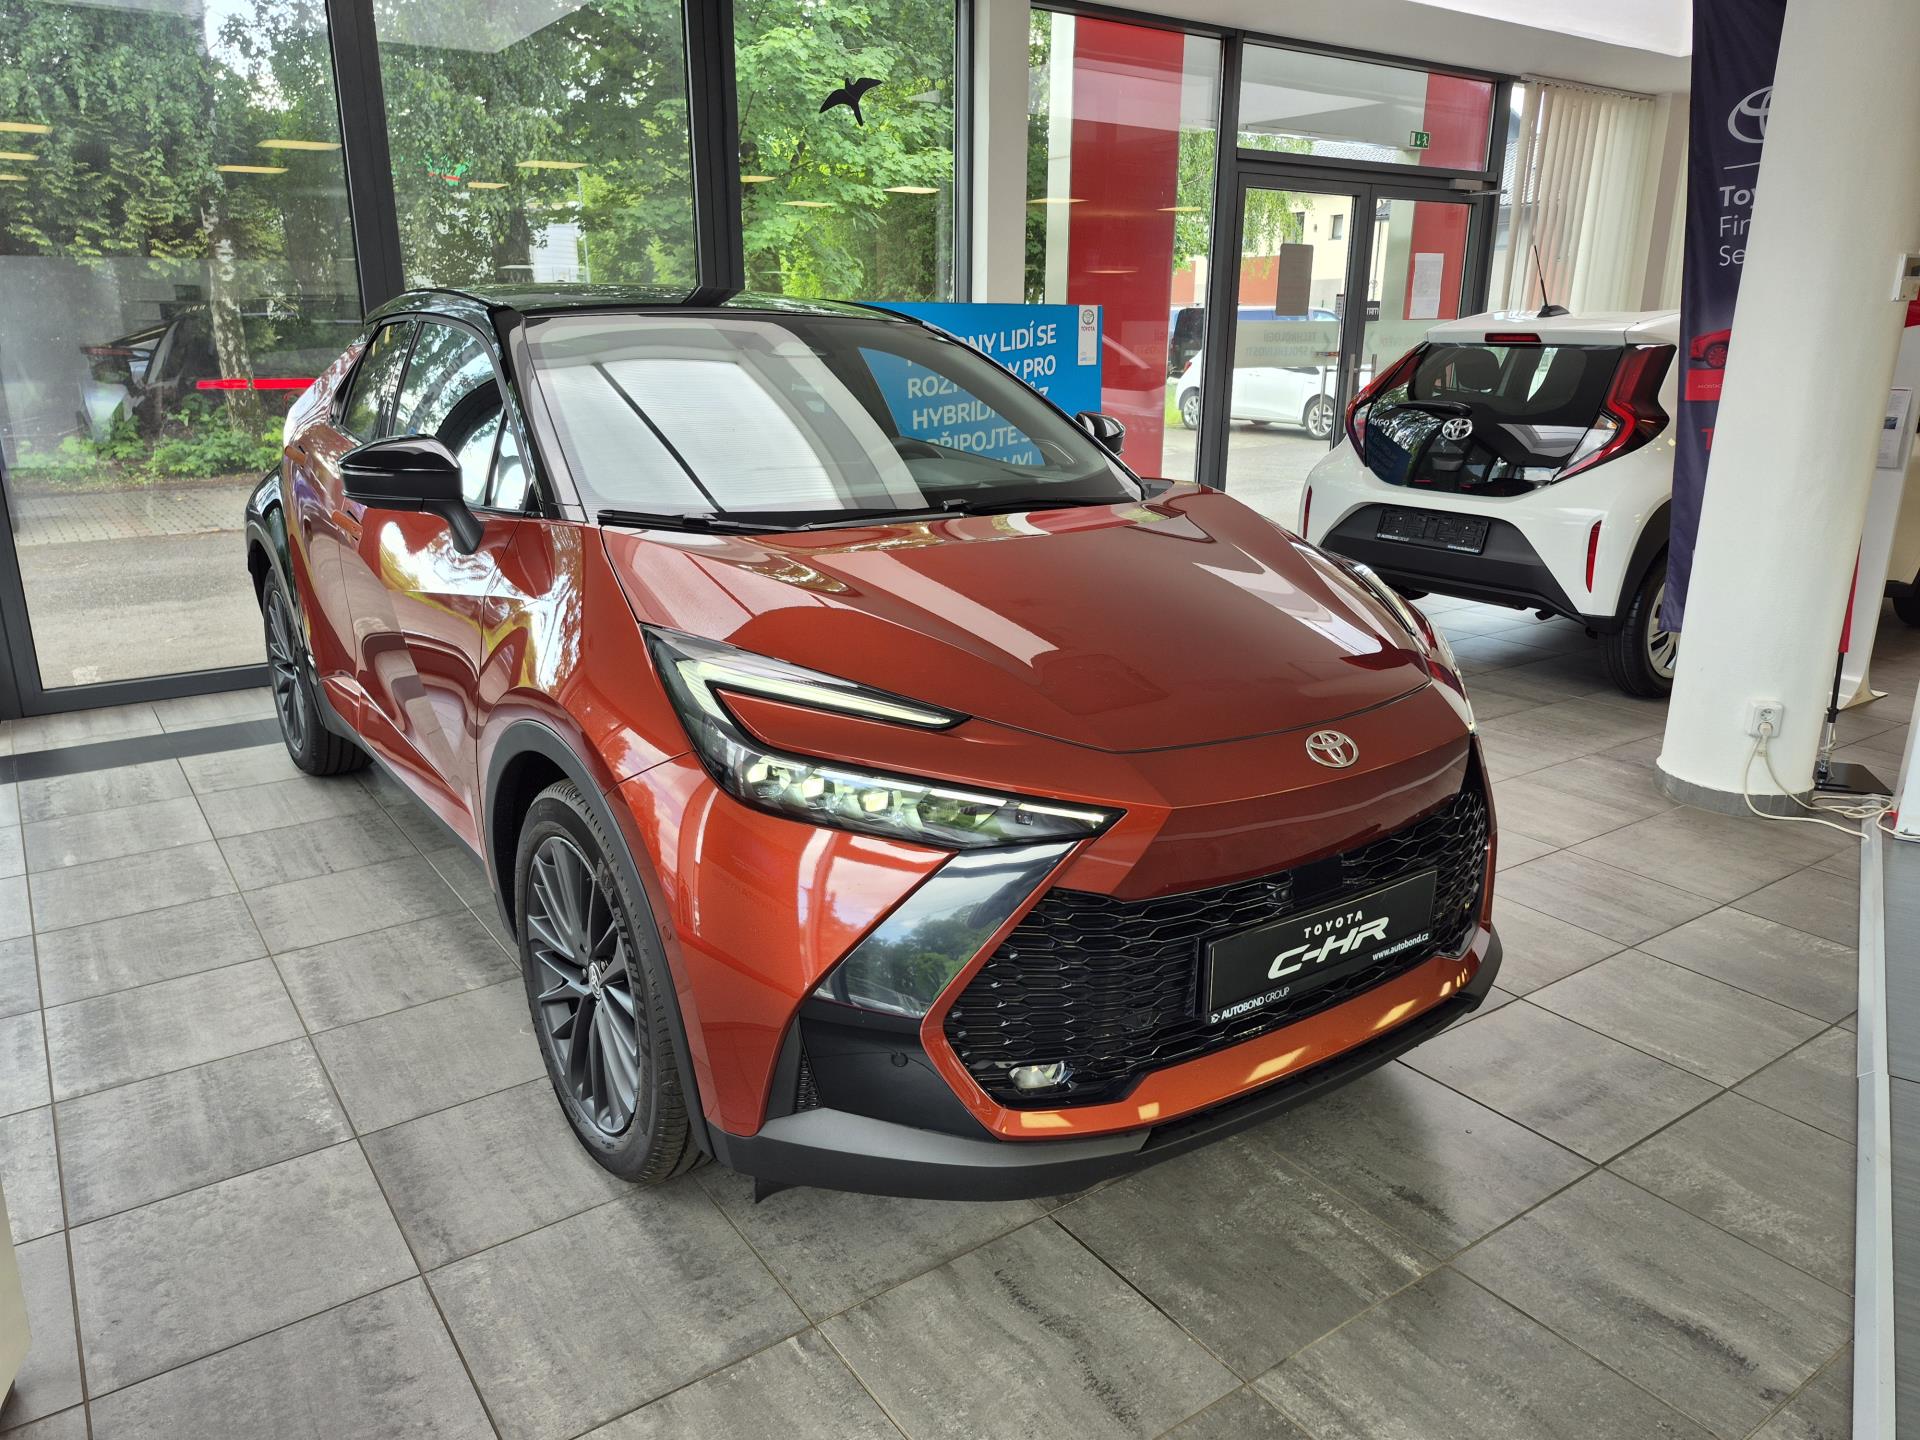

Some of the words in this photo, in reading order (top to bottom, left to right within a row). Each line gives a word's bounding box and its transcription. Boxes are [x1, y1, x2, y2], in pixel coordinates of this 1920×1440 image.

[999, 320, 1034, 352] LIDÍ
[1036, 324, 1057, 347] SE
[1023, 354, 1057, 380] PRO
[912, 401, 996, 431] HYBRID
[1304, 910, 1363, 938] TOYOTA
[1267, 916, 1389, 980] C-HR
[1372, 932, 1429, 961] www.autobond.cz
[1221, 996, 1264, 1020] AUTOBOND
[1265, 986, 1290, 1003] GROUP
